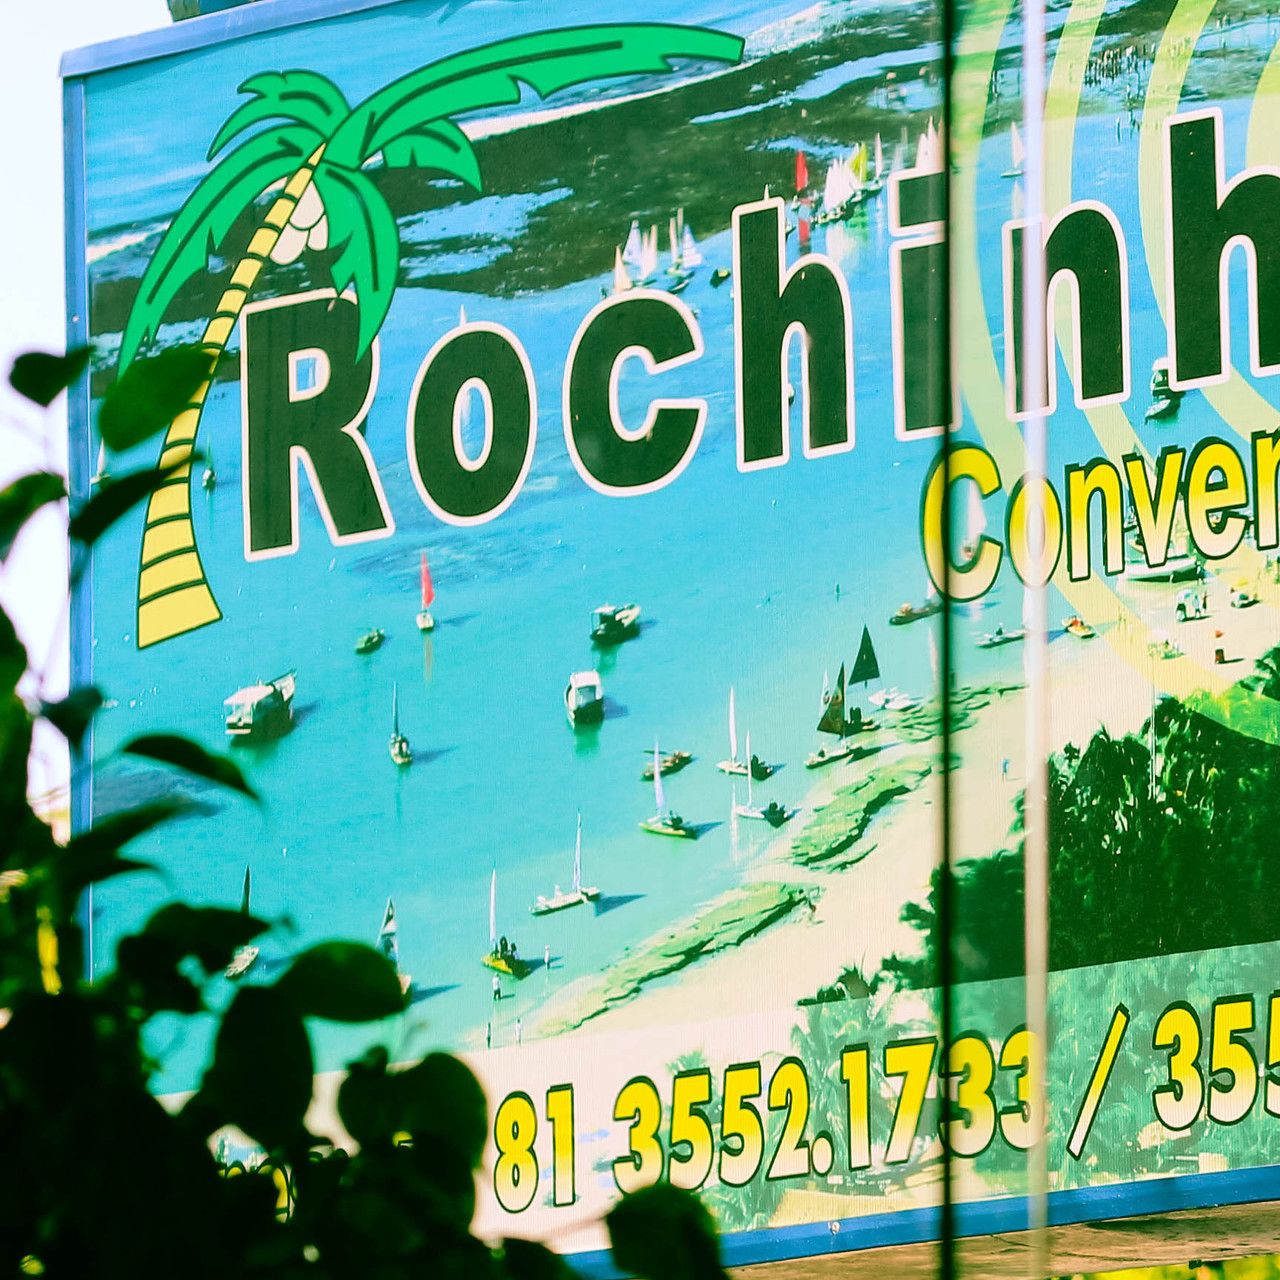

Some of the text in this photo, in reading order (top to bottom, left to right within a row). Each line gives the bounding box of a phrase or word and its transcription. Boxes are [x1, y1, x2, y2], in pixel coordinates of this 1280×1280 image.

[494, 1083, 576, 1214] 81
[612, 1023, 1045, 1194] 3552.1733
[1066, 1003, 1131, 1161] /
